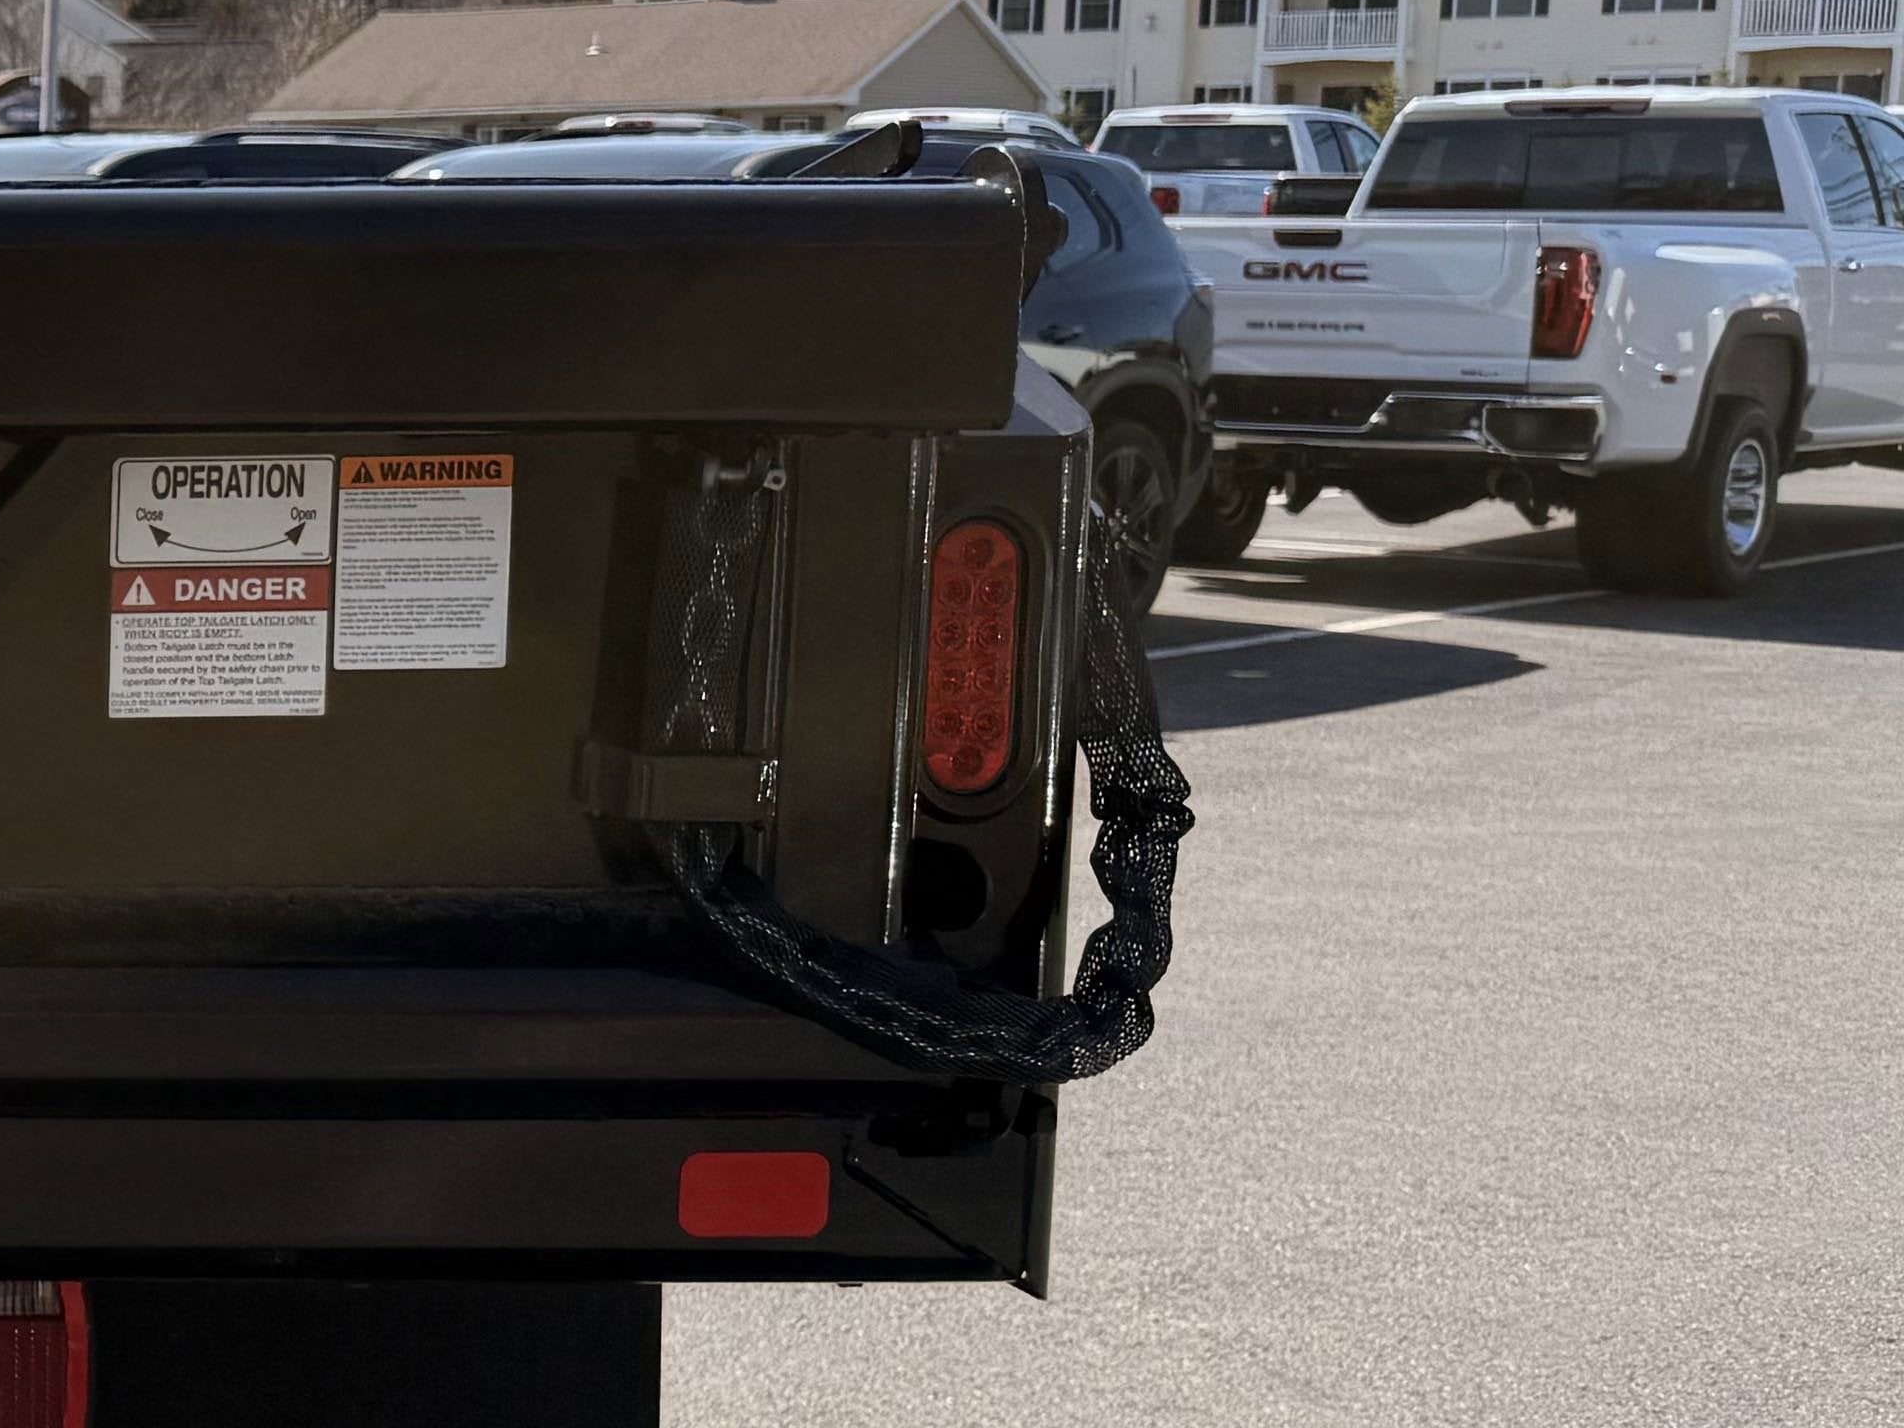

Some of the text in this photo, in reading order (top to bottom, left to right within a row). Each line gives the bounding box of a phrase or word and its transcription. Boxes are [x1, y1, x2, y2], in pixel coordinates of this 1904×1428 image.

[1243, 259, 1368, 281] GMC
[152, 463, 305, 500] OPERATION
[379, 460, 502, 482] WARNING
[136, 506, 317, 523] Close Open
[174, 577, 307, 602] DANGER
